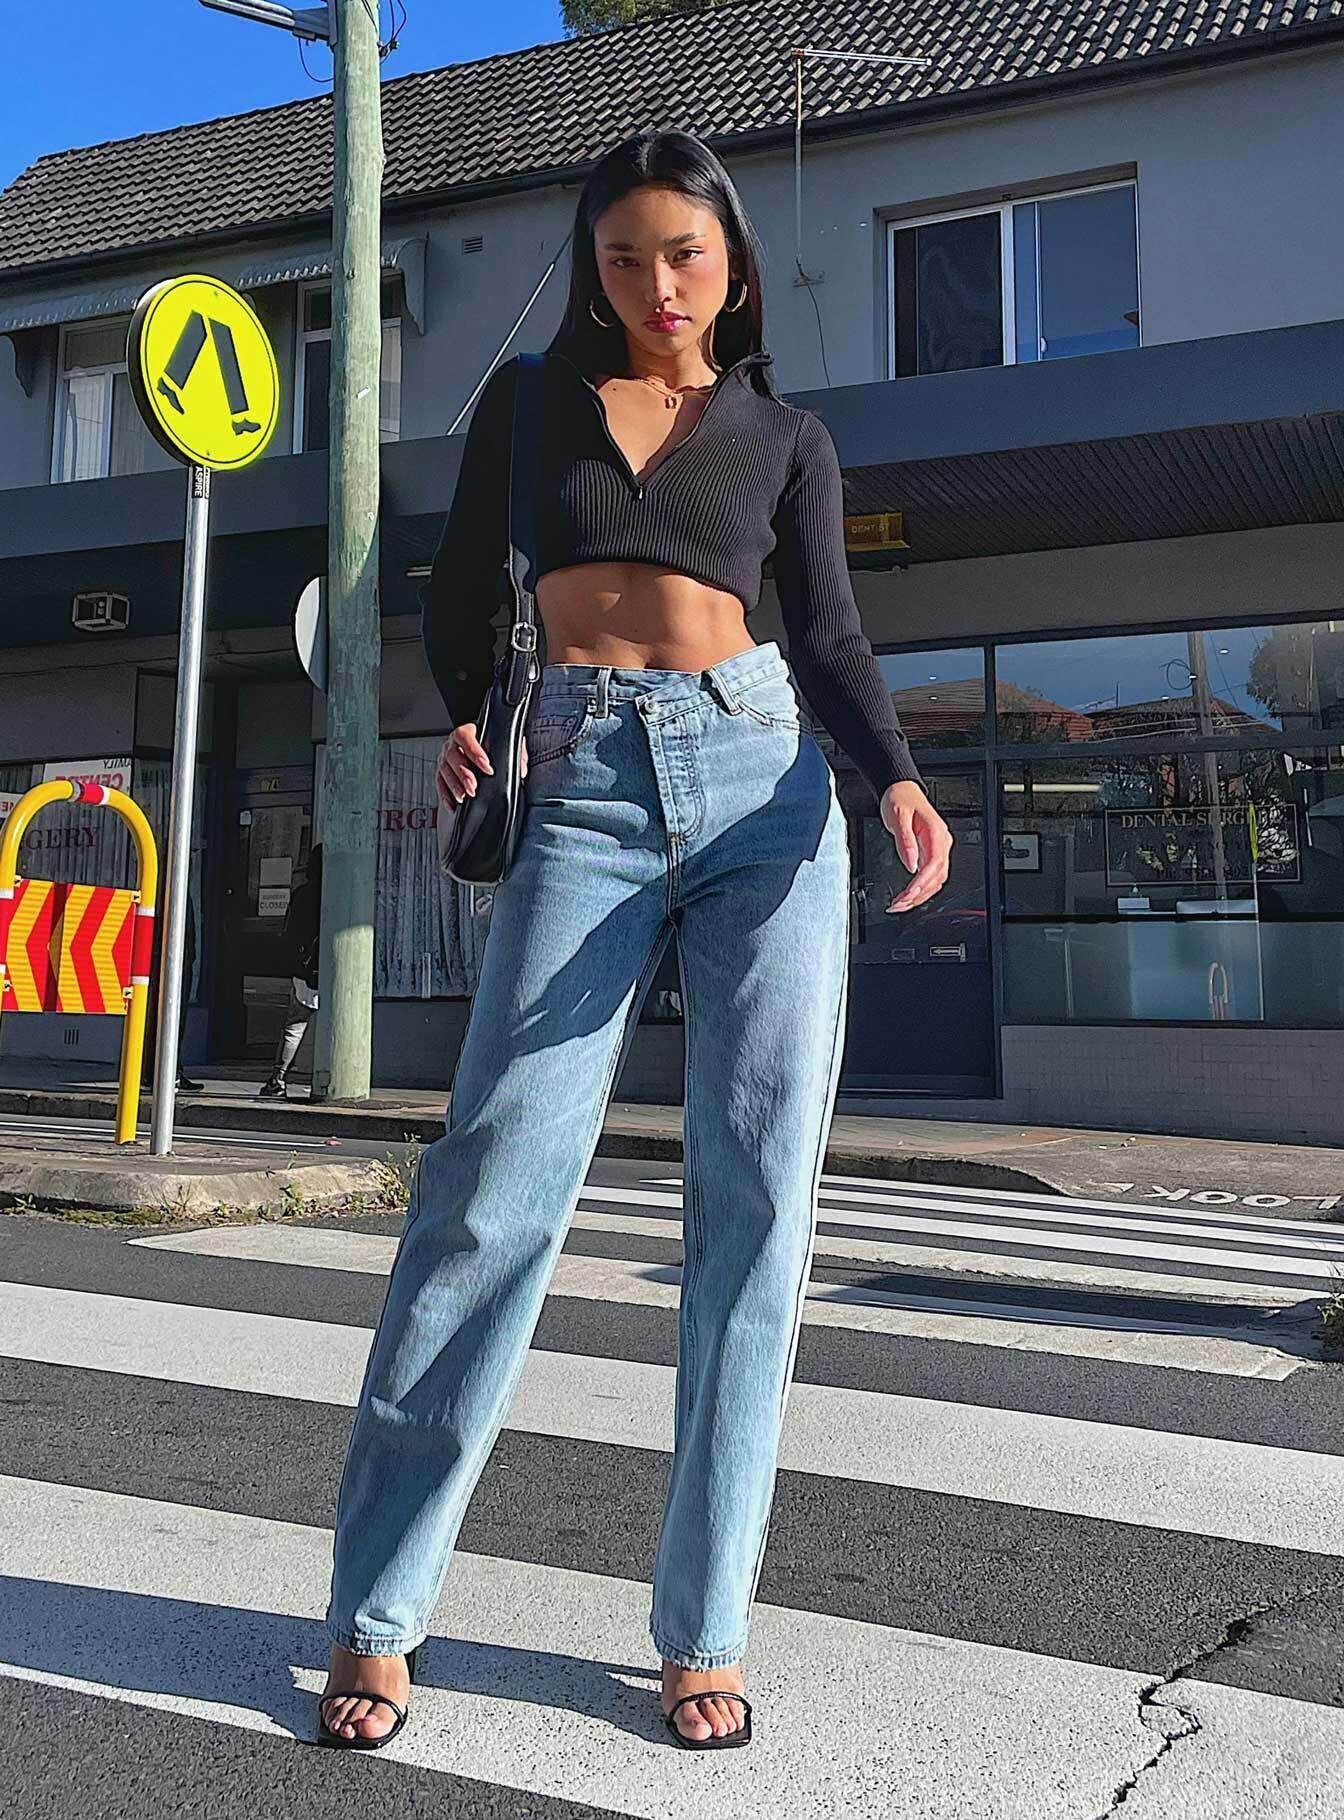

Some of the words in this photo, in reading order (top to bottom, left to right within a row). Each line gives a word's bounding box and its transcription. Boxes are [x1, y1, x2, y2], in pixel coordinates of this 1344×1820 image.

[195, 466, 203, 496] ASPIRE
[1121, 813, 1192, 829] DENTAL
[24, 826, 100, 850] GERY
[1141, 1185, 1342, 1210] LOOK
